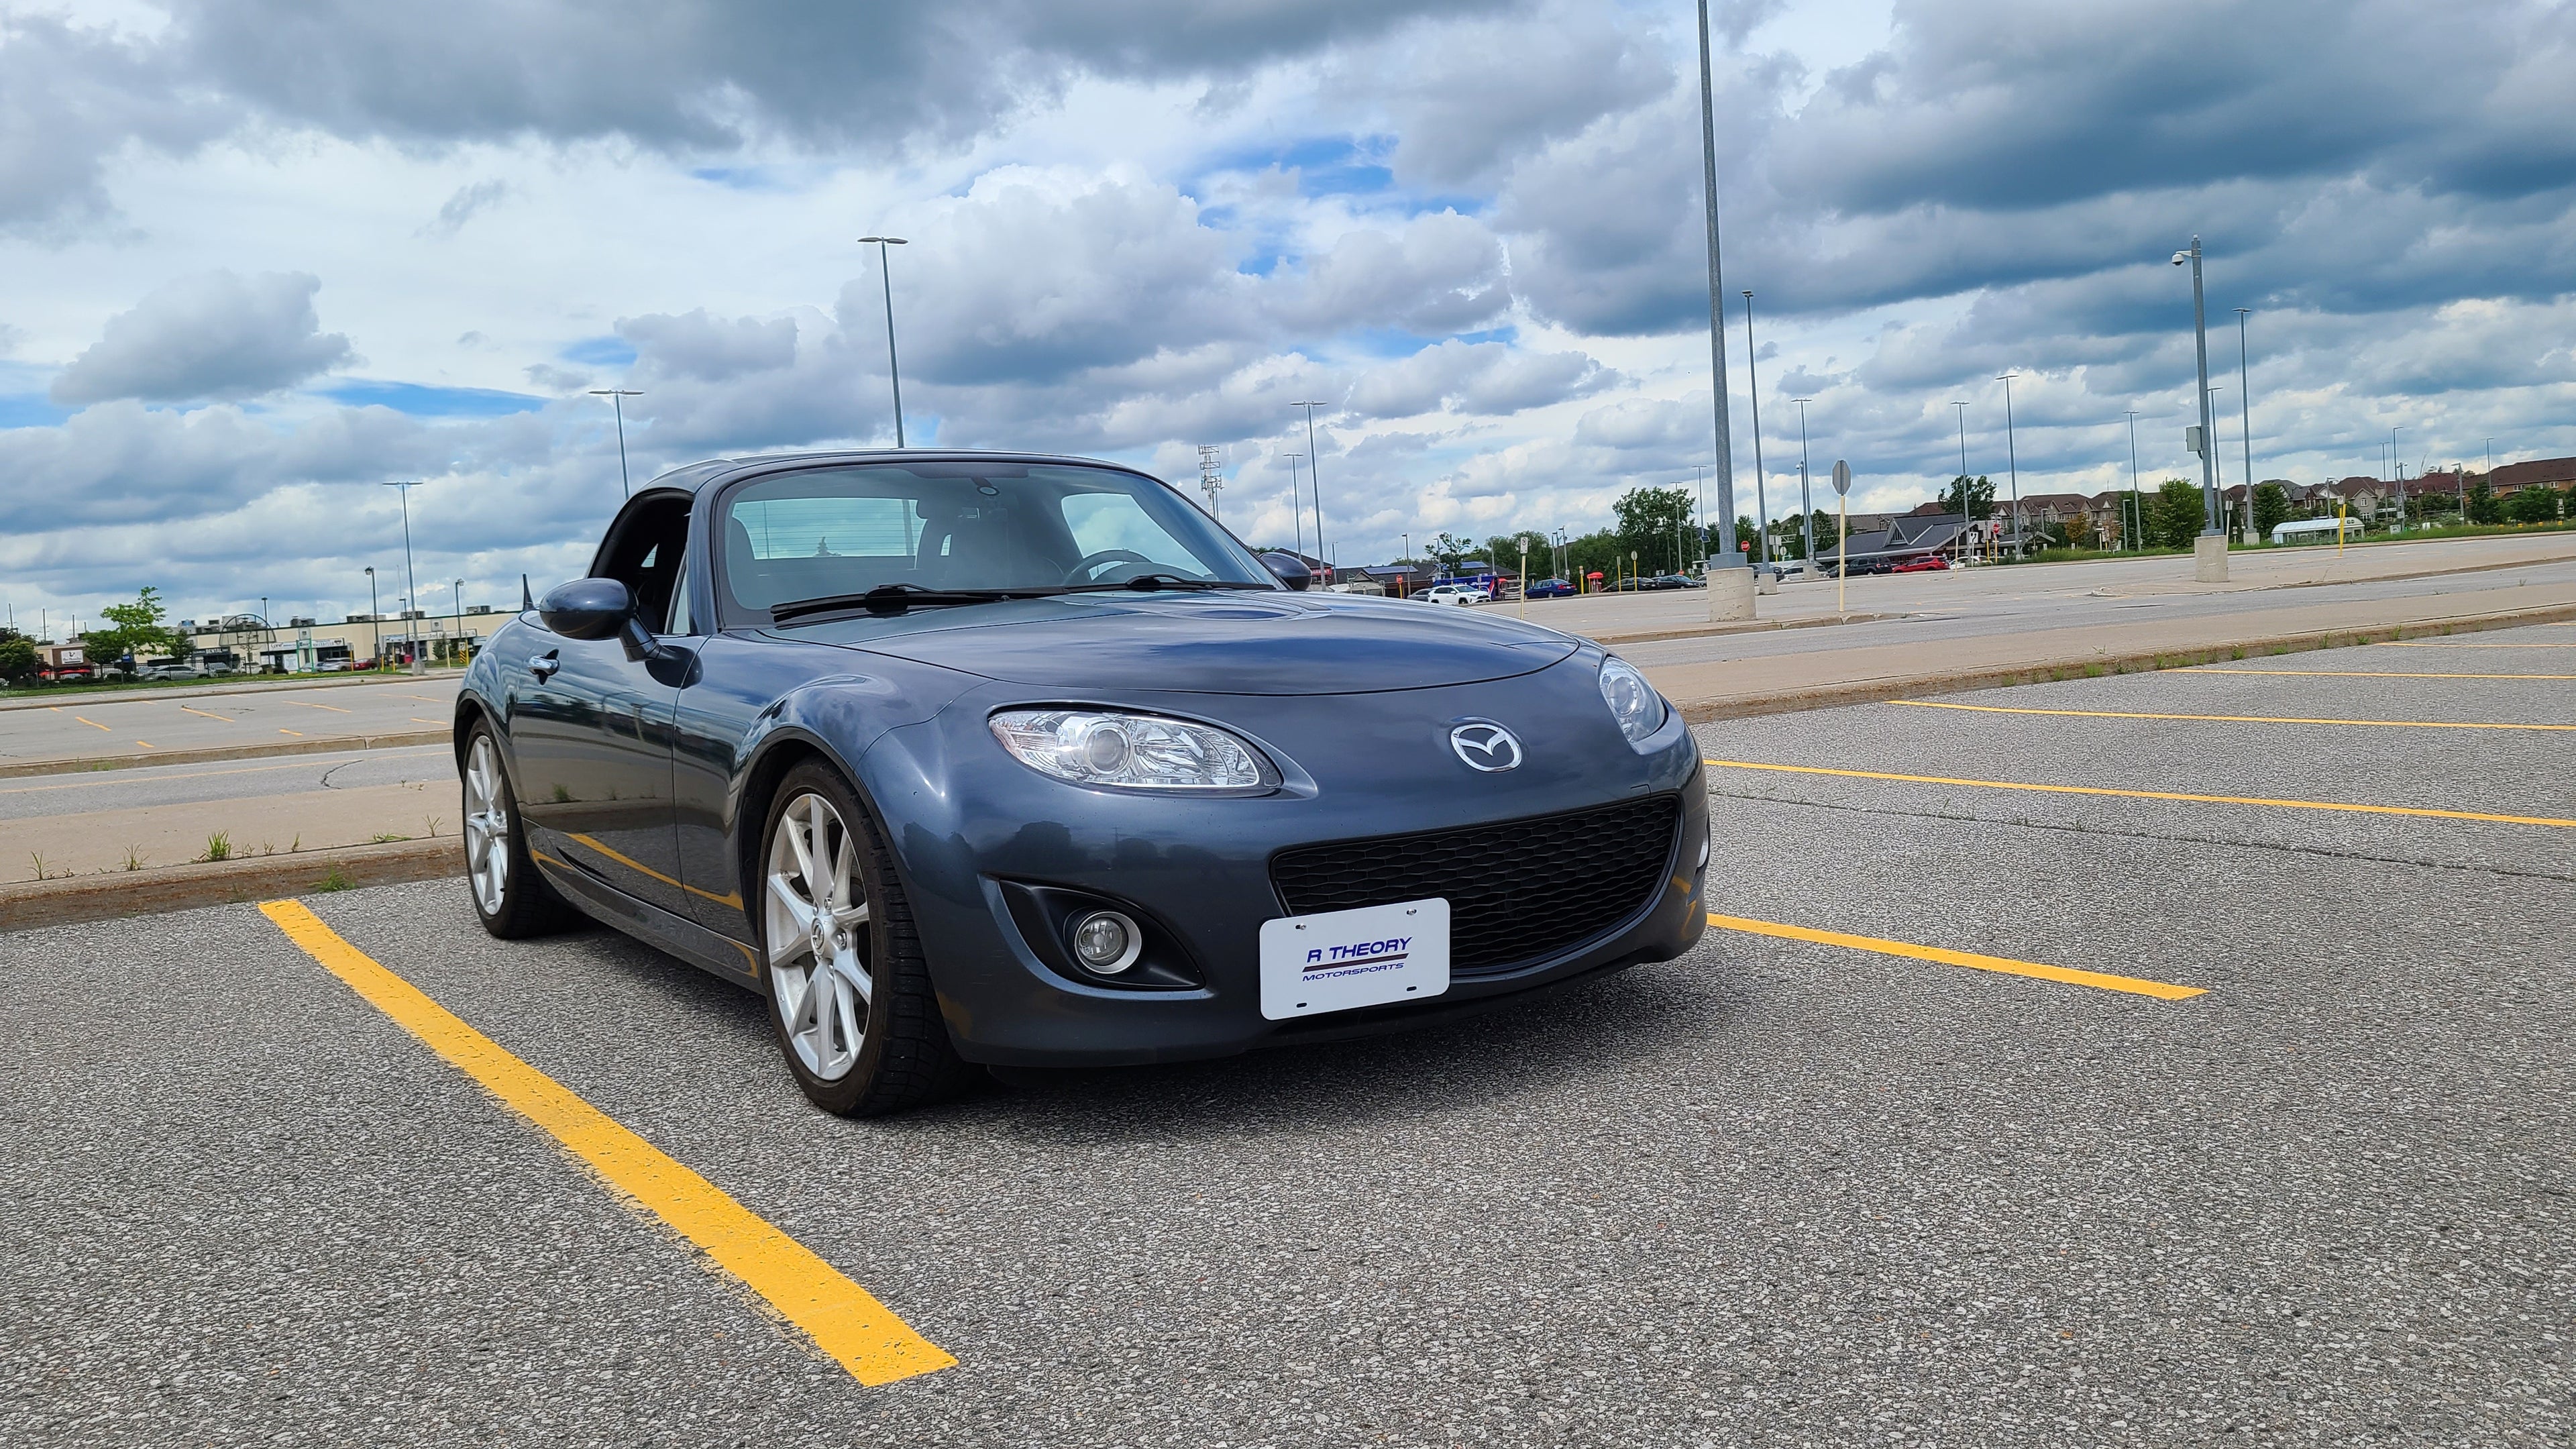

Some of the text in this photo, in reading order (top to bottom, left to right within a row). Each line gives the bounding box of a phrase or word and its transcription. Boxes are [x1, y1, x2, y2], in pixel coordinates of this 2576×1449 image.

[1307, 936, 1413, 963] R THEORY
[1302, 962, 1404, 981] MOTORSPORTS
